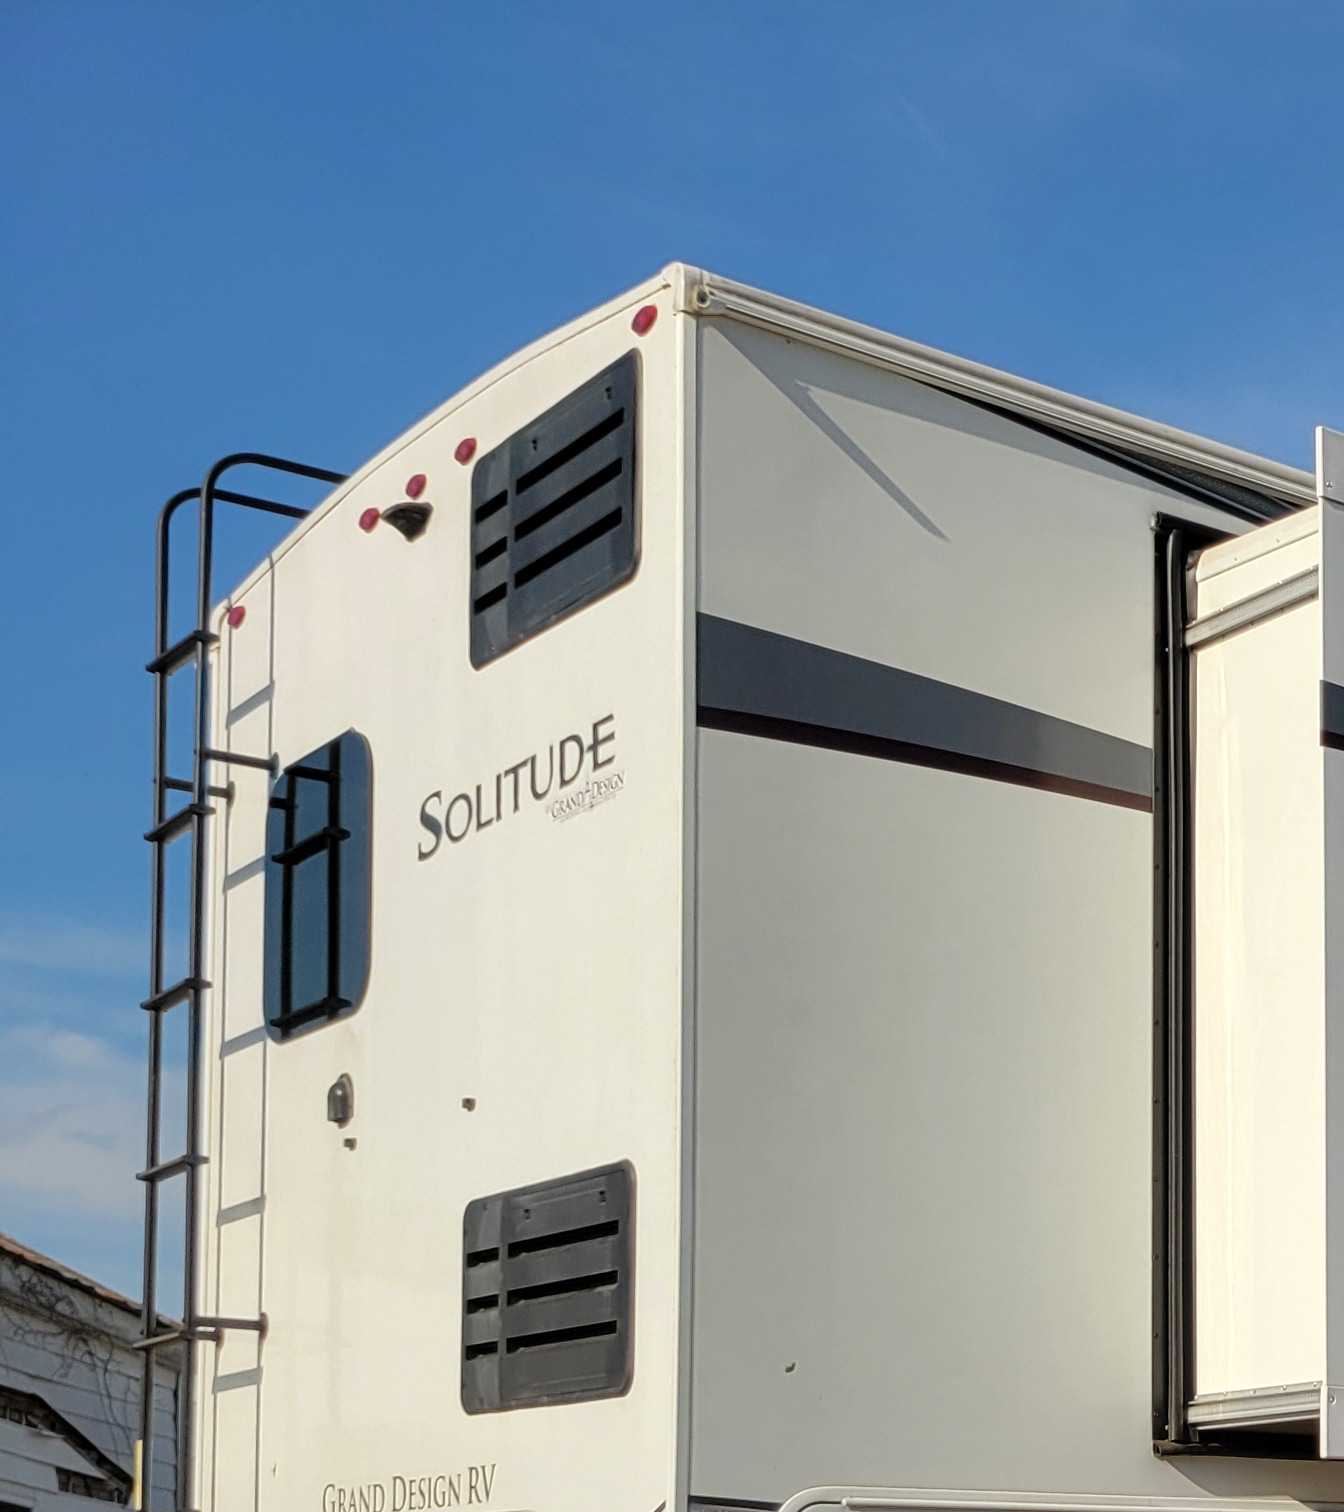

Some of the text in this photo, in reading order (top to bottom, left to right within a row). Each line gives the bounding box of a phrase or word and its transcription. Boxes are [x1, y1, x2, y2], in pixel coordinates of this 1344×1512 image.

[417, 713, 616, 862] SOLITUDE
[392, 1474, 462, 1512] DESIGN
[467, 1463, 497, 1505] RV
